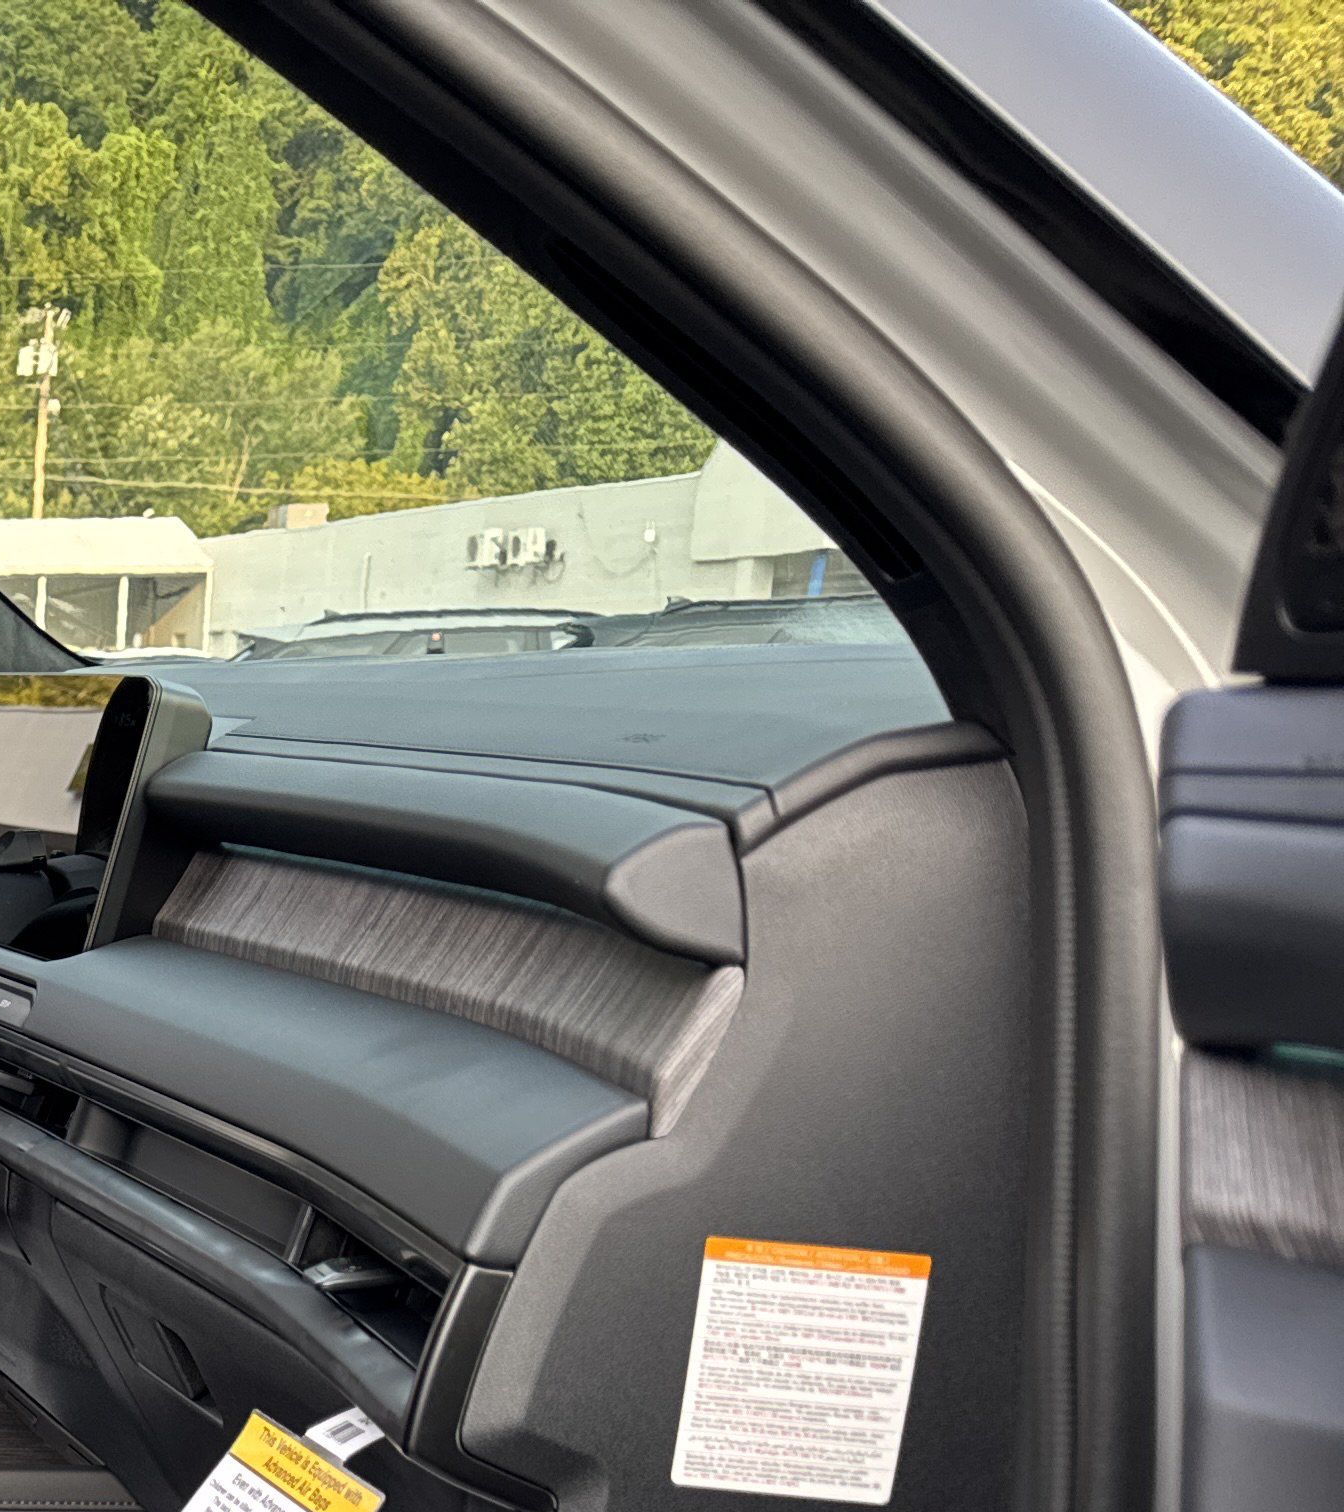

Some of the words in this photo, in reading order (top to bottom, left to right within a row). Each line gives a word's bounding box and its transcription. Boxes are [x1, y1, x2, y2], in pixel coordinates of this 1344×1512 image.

[232, 1473, 250, 1491] Even
[247, 1484, 263, 1501] with
[258, 1427, 278, 1446] This
[275, 1438, 304, 1464] Vehicle
[300, 1456, 311, 1469] is
[306, 1461, 346, 1496] Equipped
[343, 1485, 364, 1506] with
[263, 1456, 300, 1488] Advanced
[296, 1480, 312, 1496] Air
[306, 1487, 332, 1512] Bags
